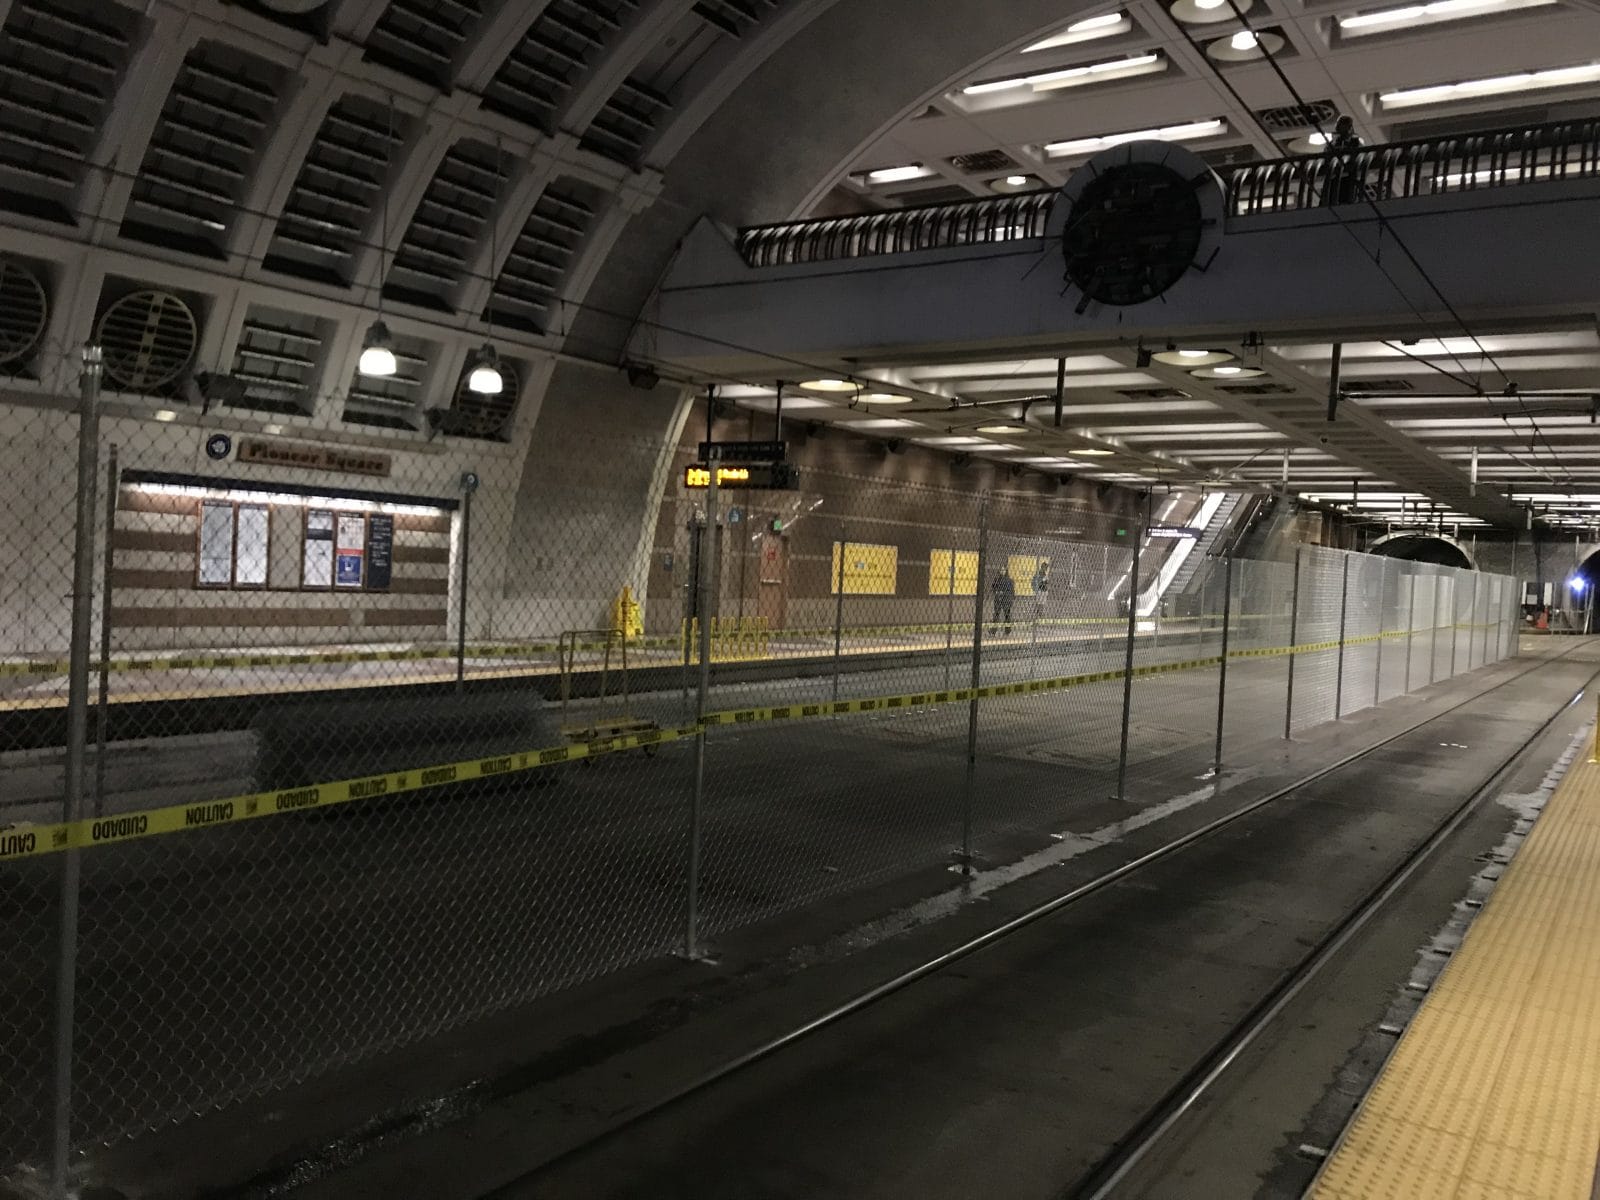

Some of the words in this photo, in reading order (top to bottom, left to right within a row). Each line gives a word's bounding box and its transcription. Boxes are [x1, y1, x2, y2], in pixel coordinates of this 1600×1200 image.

[250, 442, 320, 464] Pioneer
[350, 778, 388, 798] CAUTION
[276, 789, 319, 810] CUIDADO
[186, 802, 234, 825] CAUTION
[92, 815, 148, 840] CUIDADO
